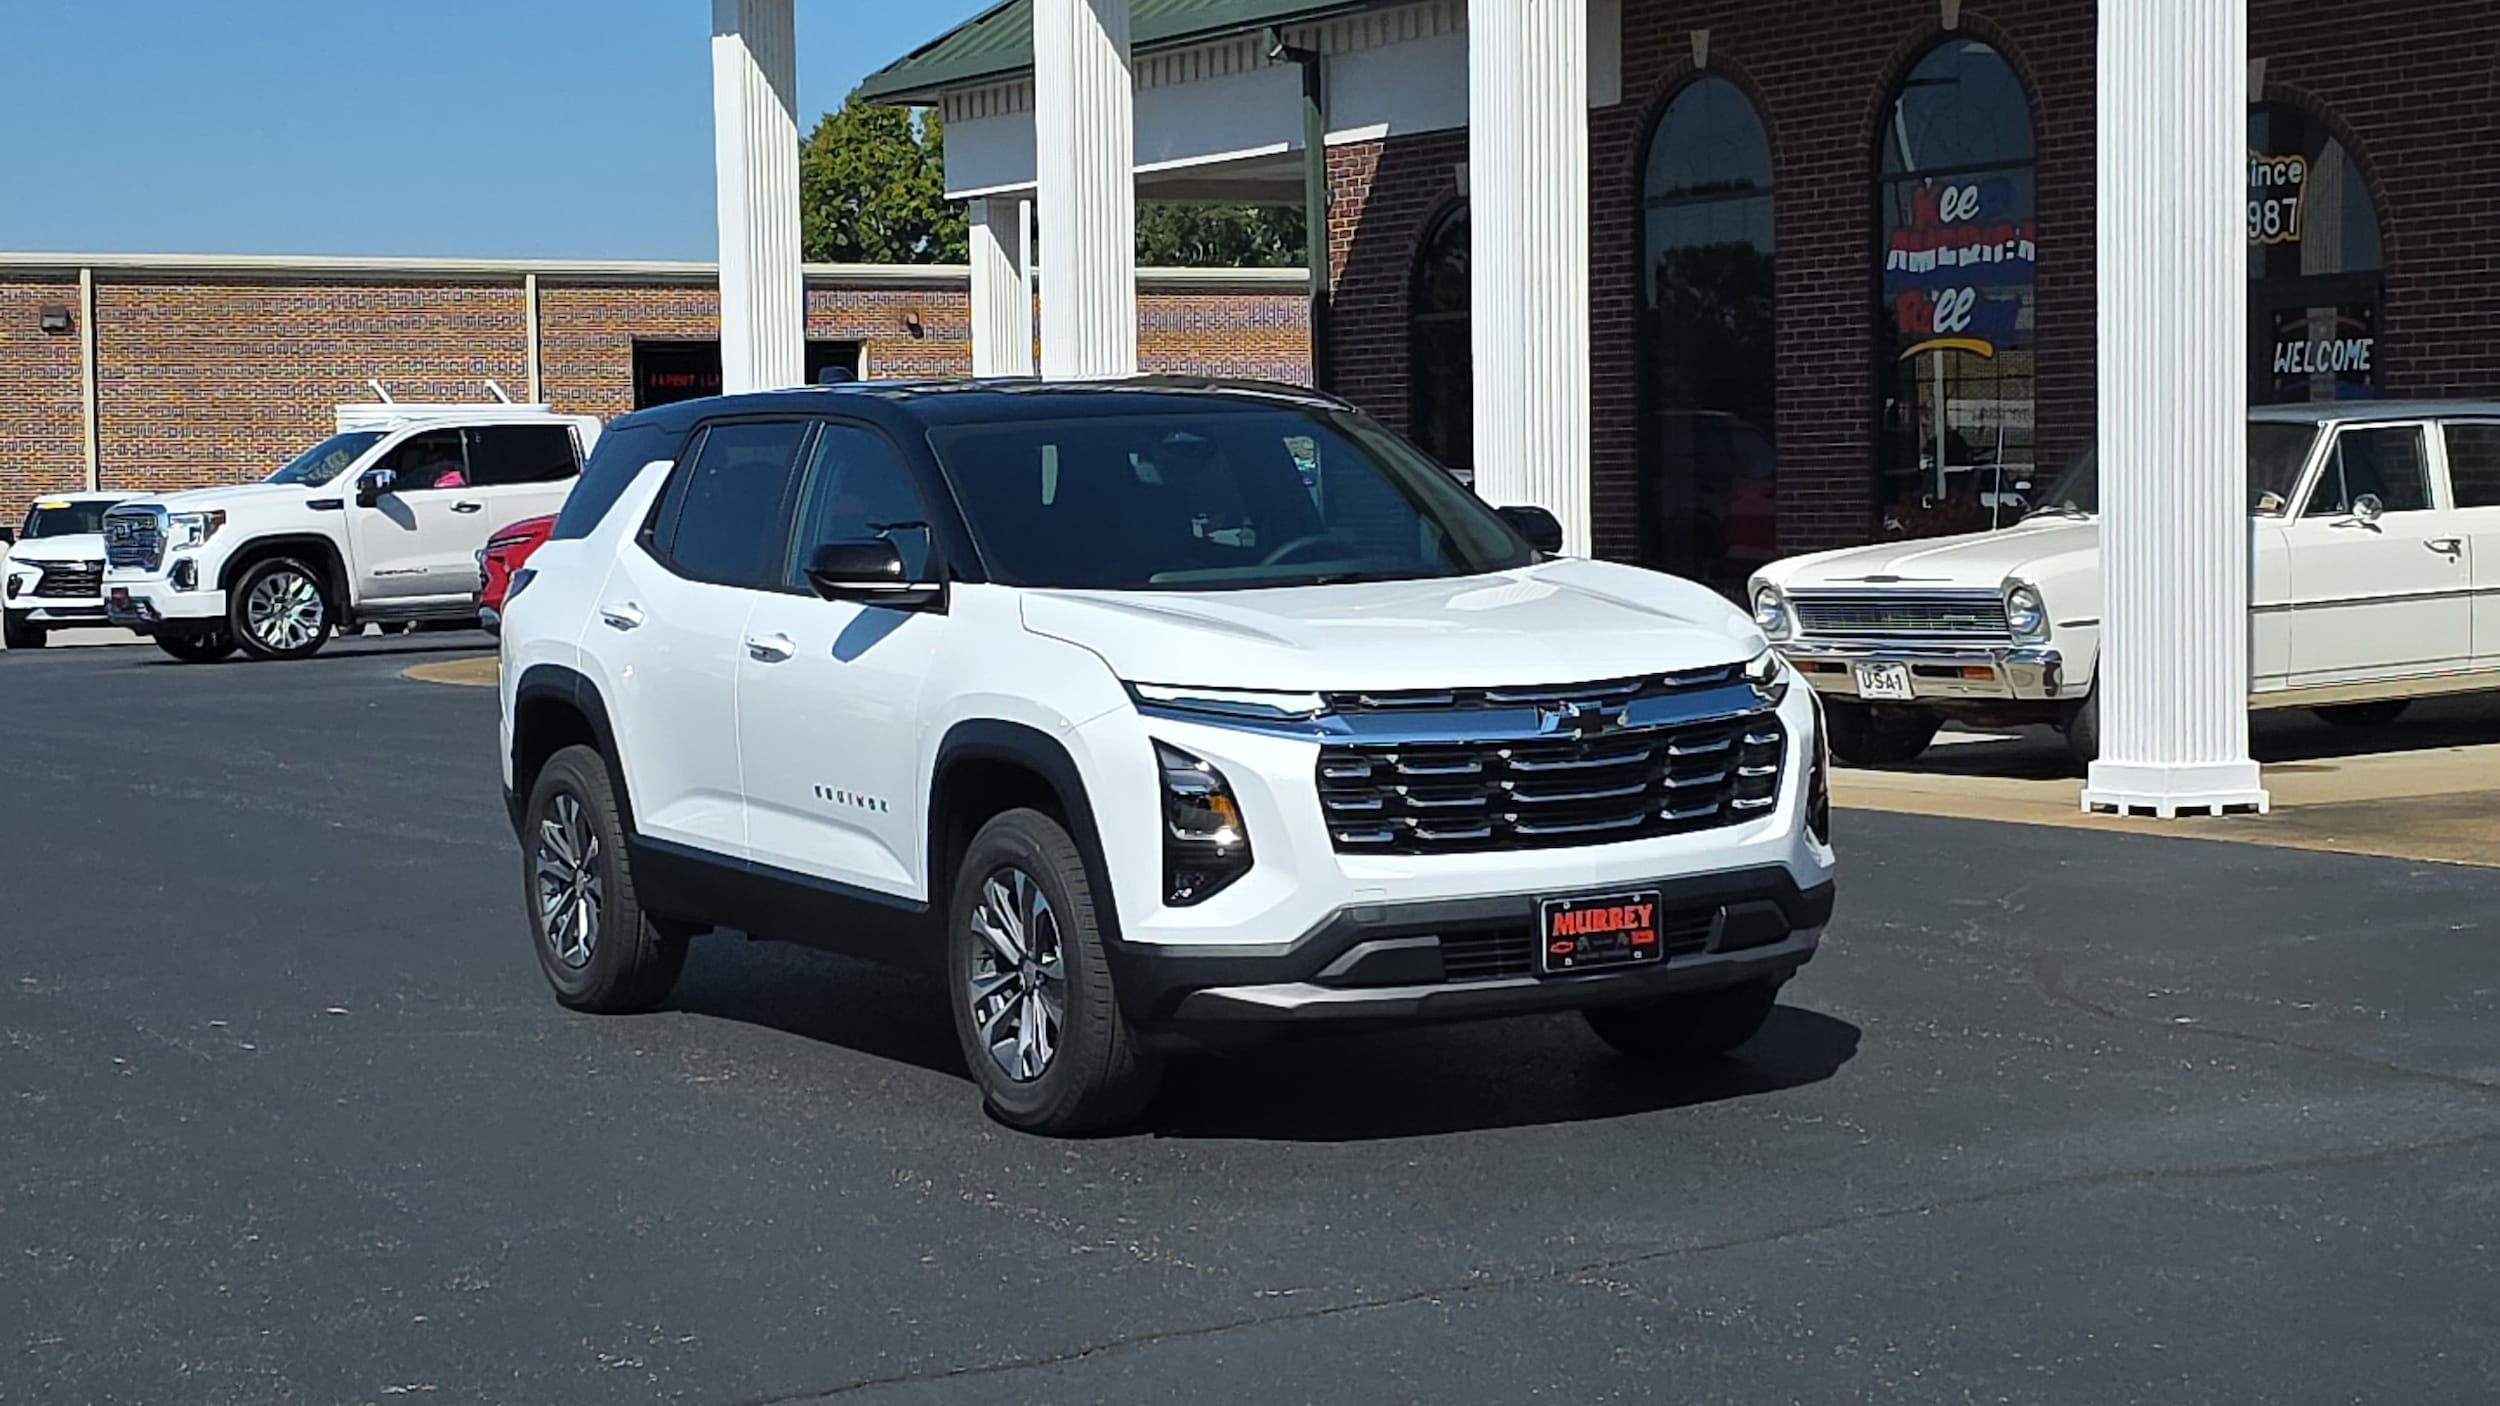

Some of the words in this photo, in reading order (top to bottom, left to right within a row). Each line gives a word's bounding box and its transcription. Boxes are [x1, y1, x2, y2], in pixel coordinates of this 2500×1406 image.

[2248, 158, 2302, 187] ince
[2248, 197, 2298, 238] 987
[2273, 338, 2374, 373] WELCOME
[1552, 903, 1653, 937] MURREY
